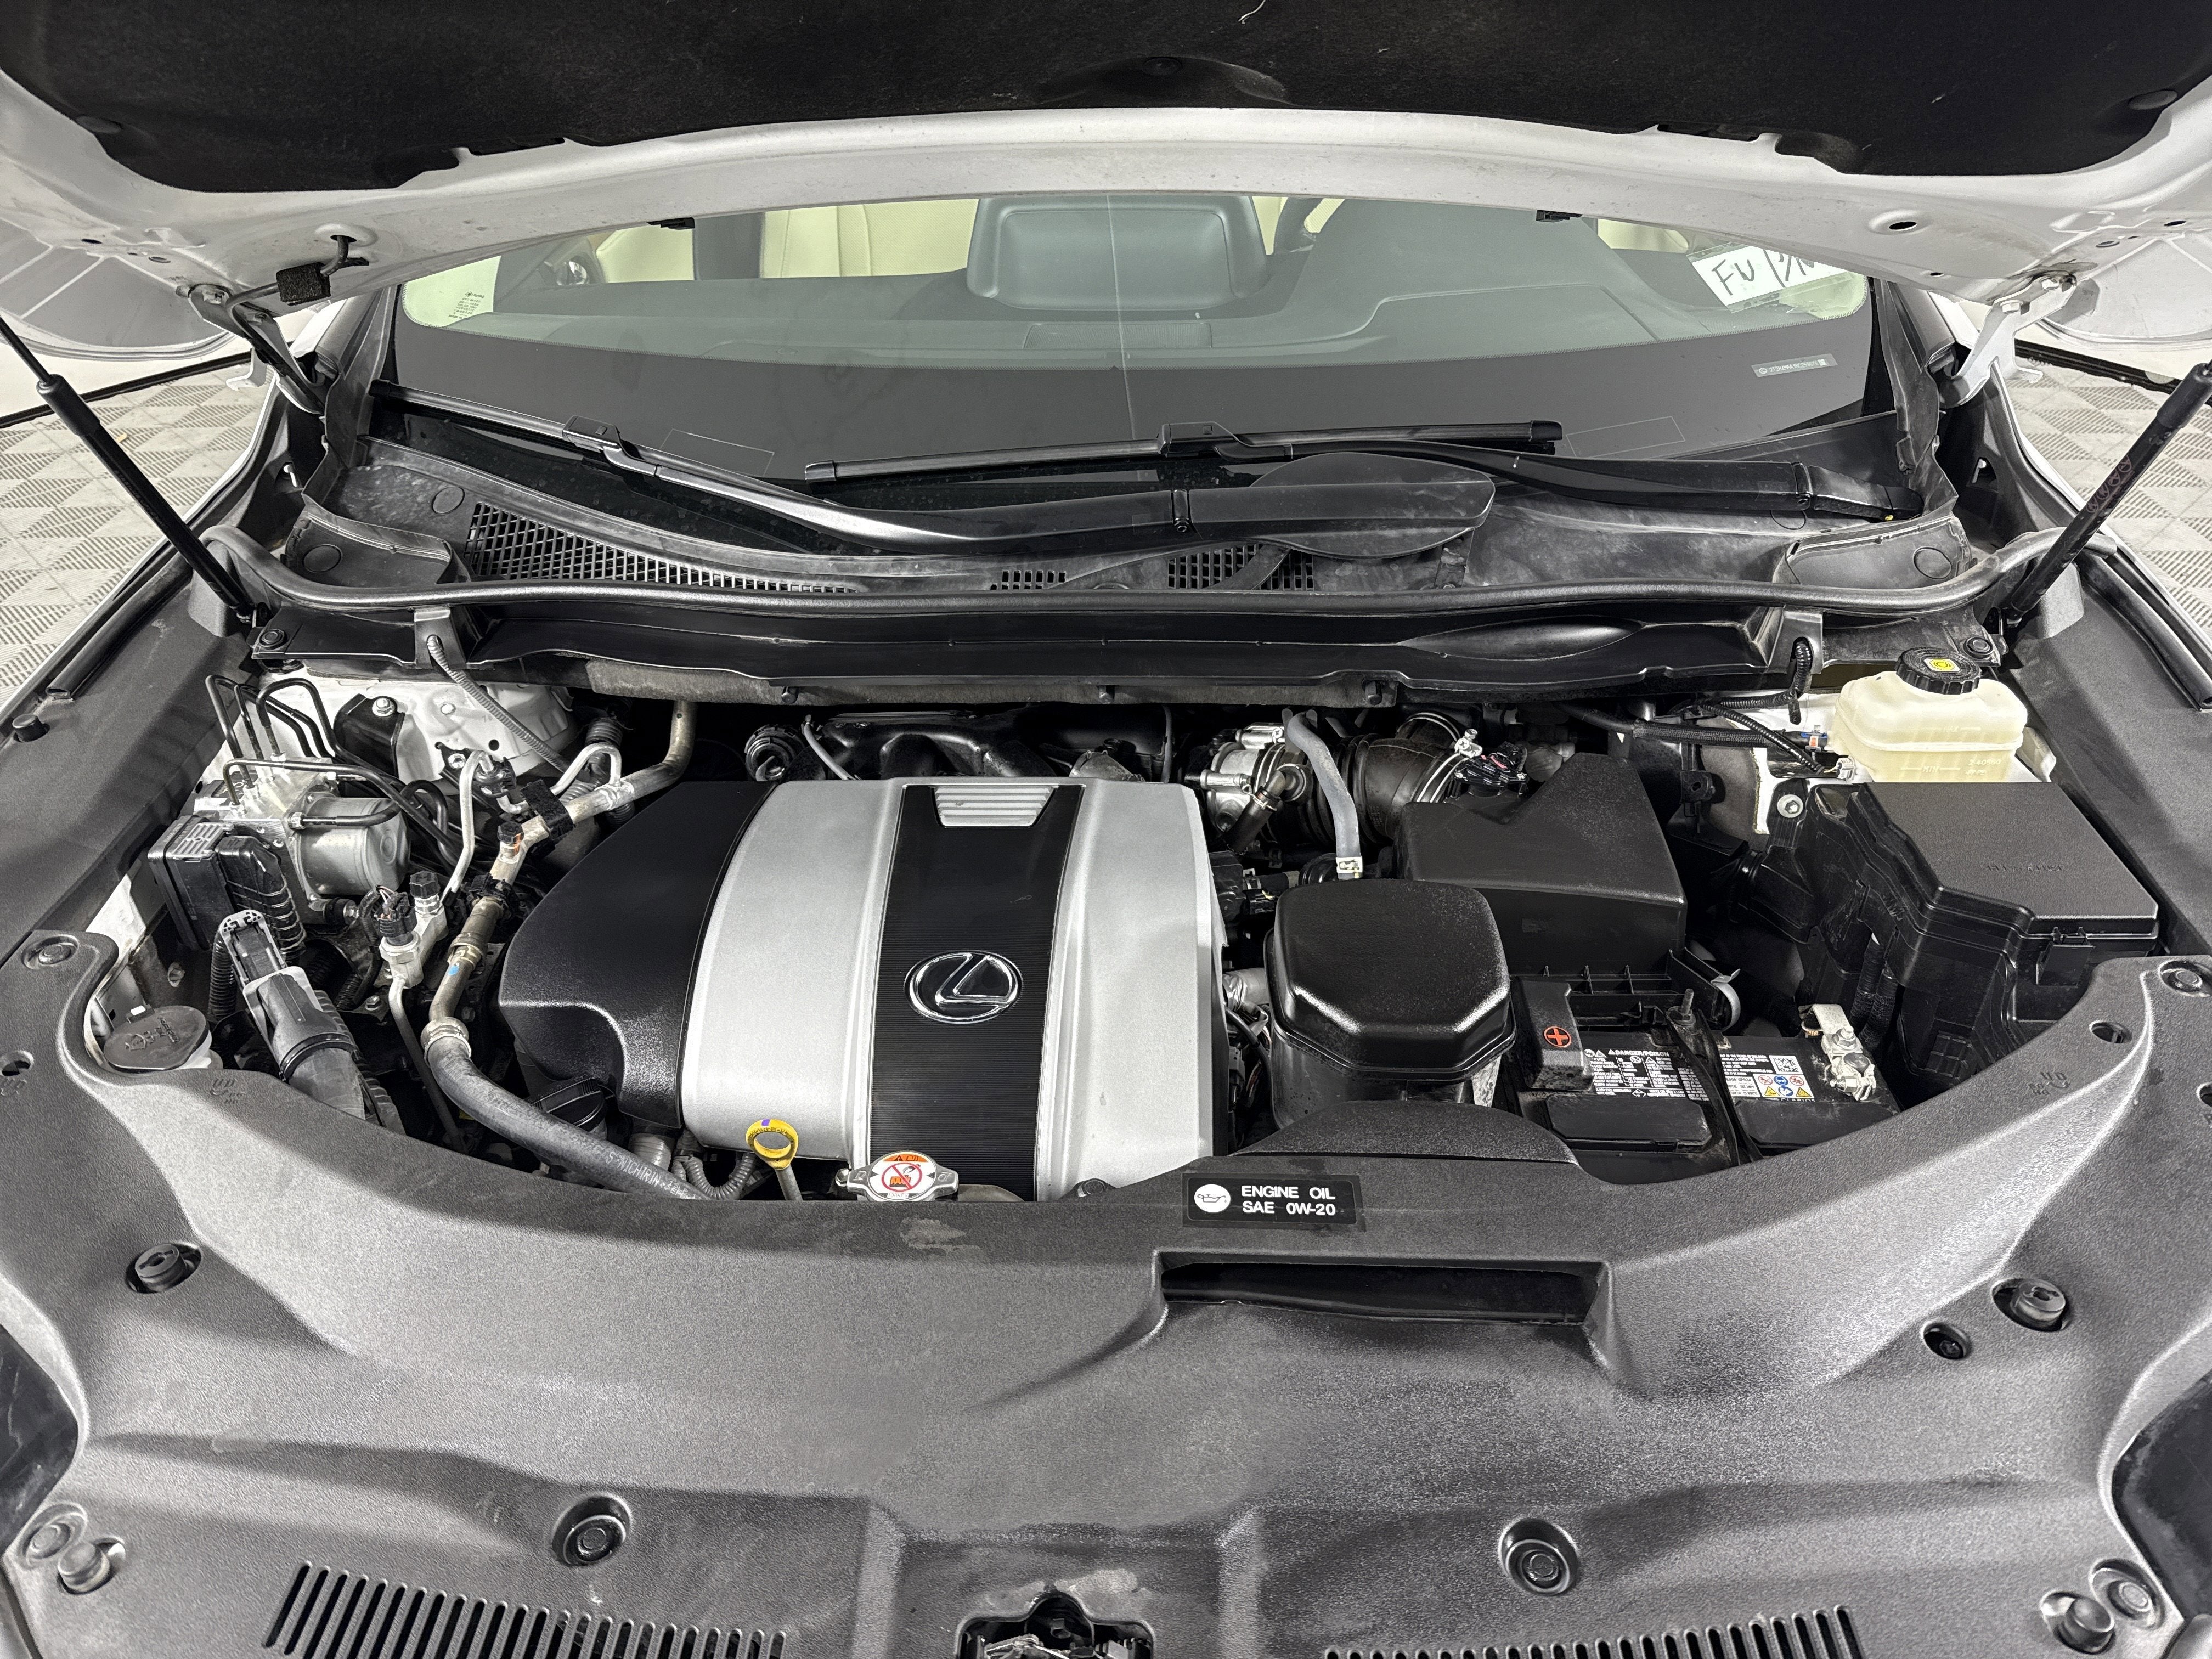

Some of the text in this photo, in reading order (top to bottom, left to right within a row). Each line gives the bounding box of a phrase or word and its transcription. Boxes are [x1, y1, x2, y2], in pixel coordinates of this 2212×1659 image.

[617, 1155, 662, 1188] NICHIRIN
[1241, 1185, 1336, 1200] ENGINE OIL
[1242, 1201, 1336, 1216] SAE 0W-20
